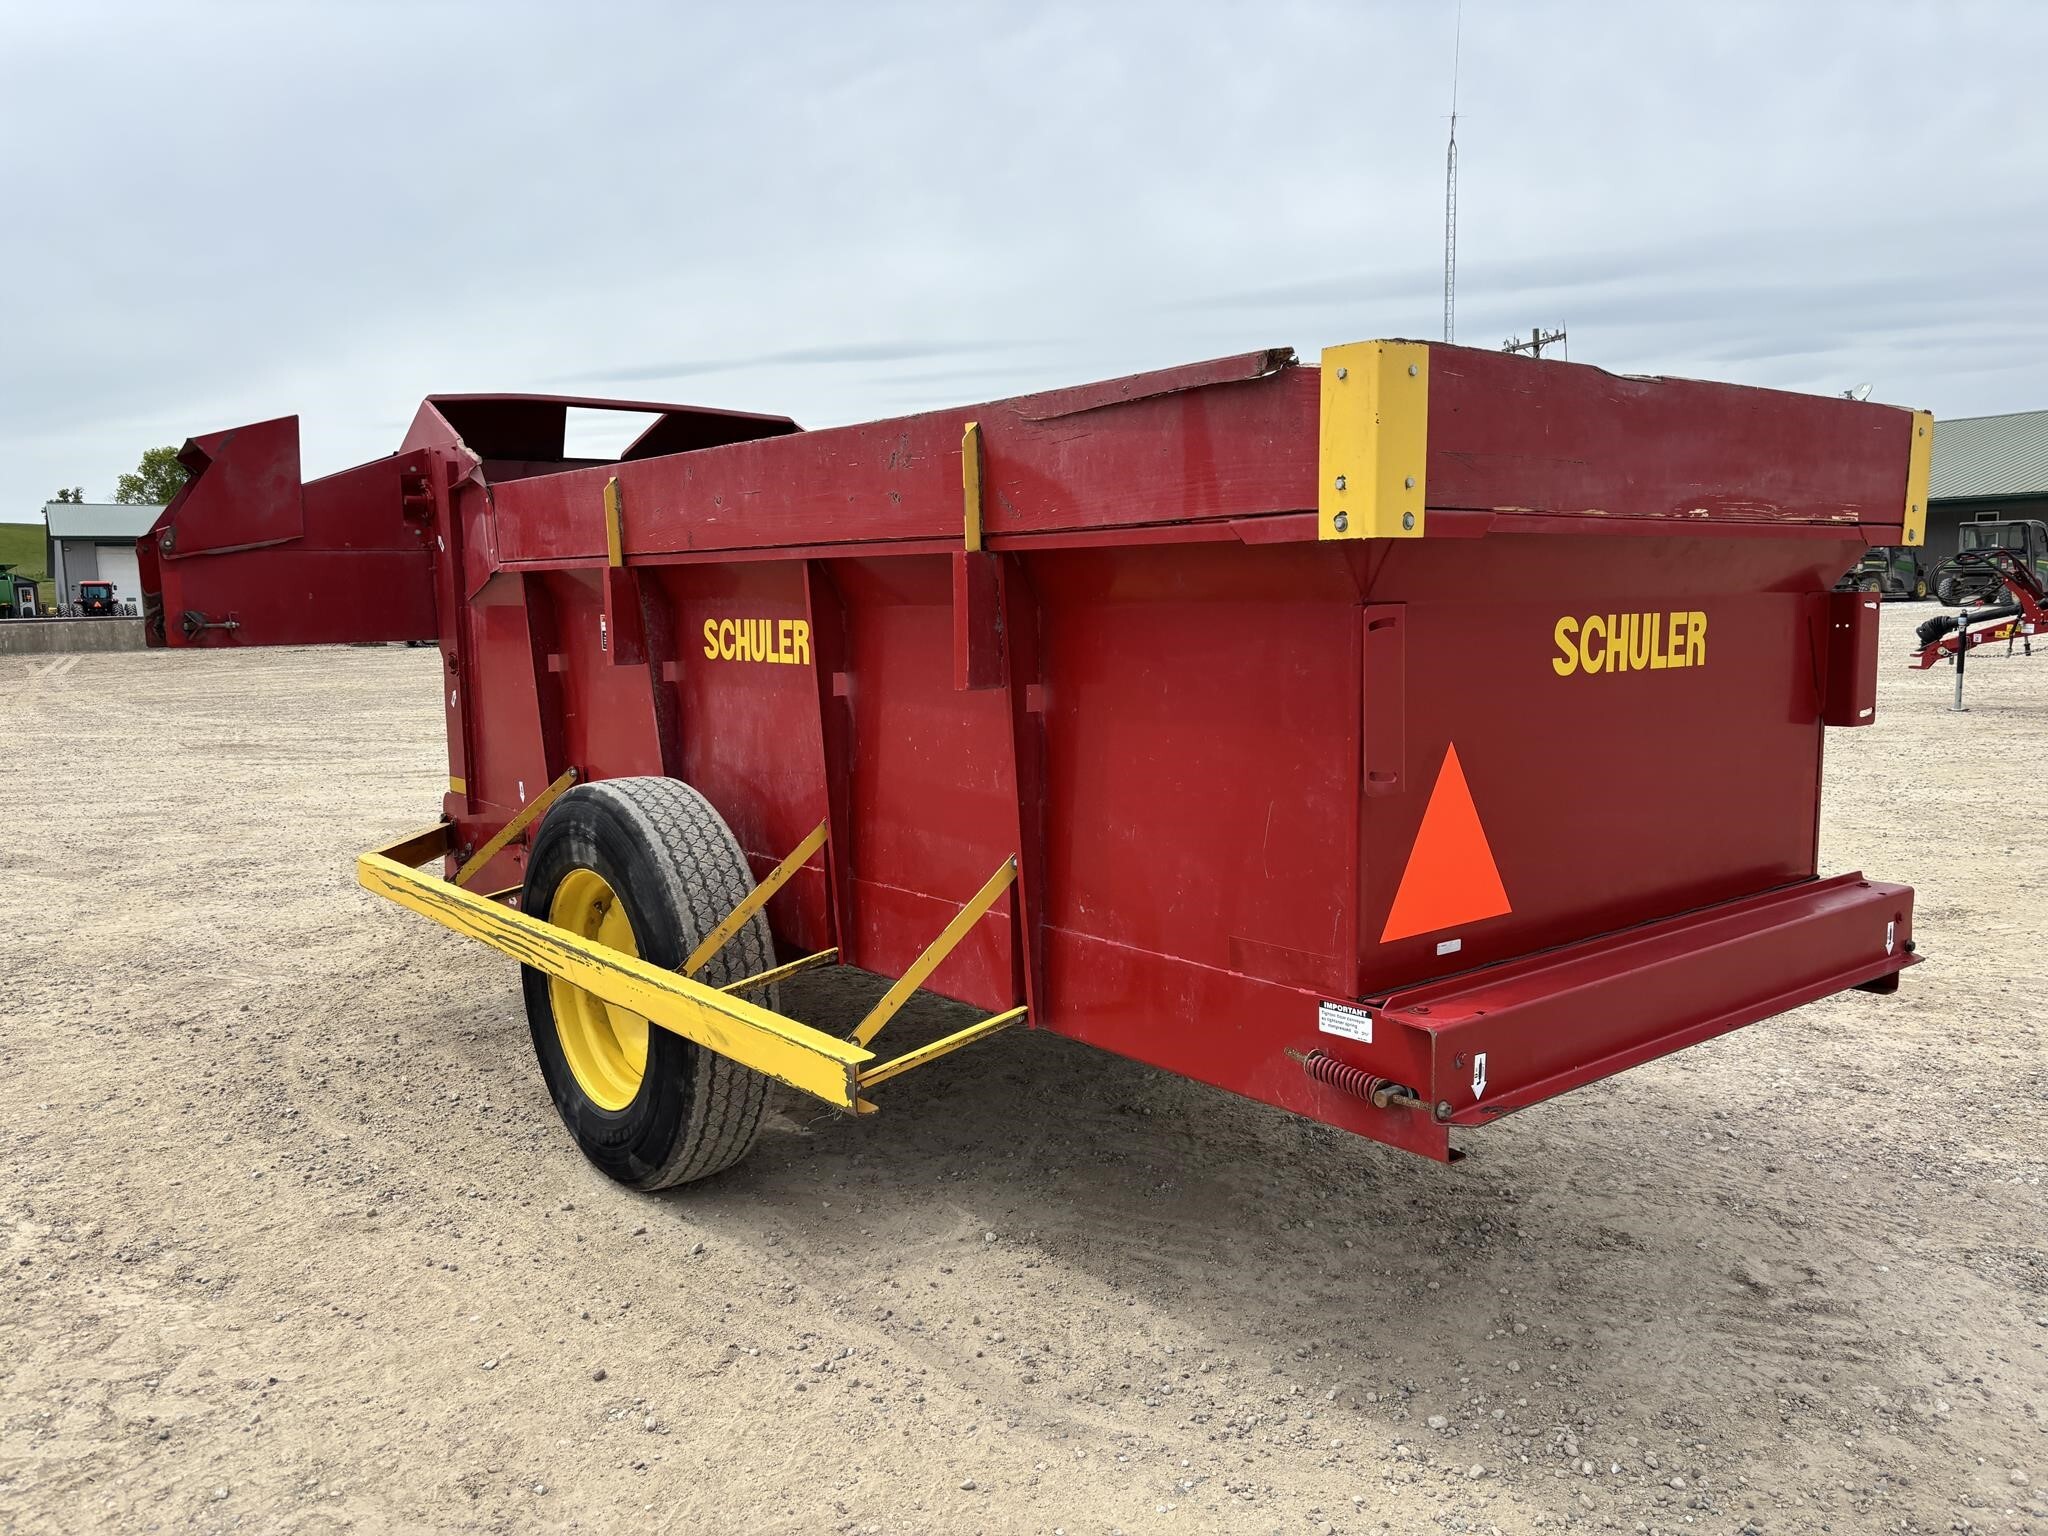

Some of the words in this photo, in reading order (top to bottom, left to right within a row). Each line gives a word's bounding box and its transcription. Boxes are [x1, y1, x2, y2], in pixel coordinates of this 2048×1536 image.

[703, 618, 811, 665] SCHULER
[1553, 612, 1707, 677] SCHULER
[1323, 1001, 1368, 1017] IMPORTANT
